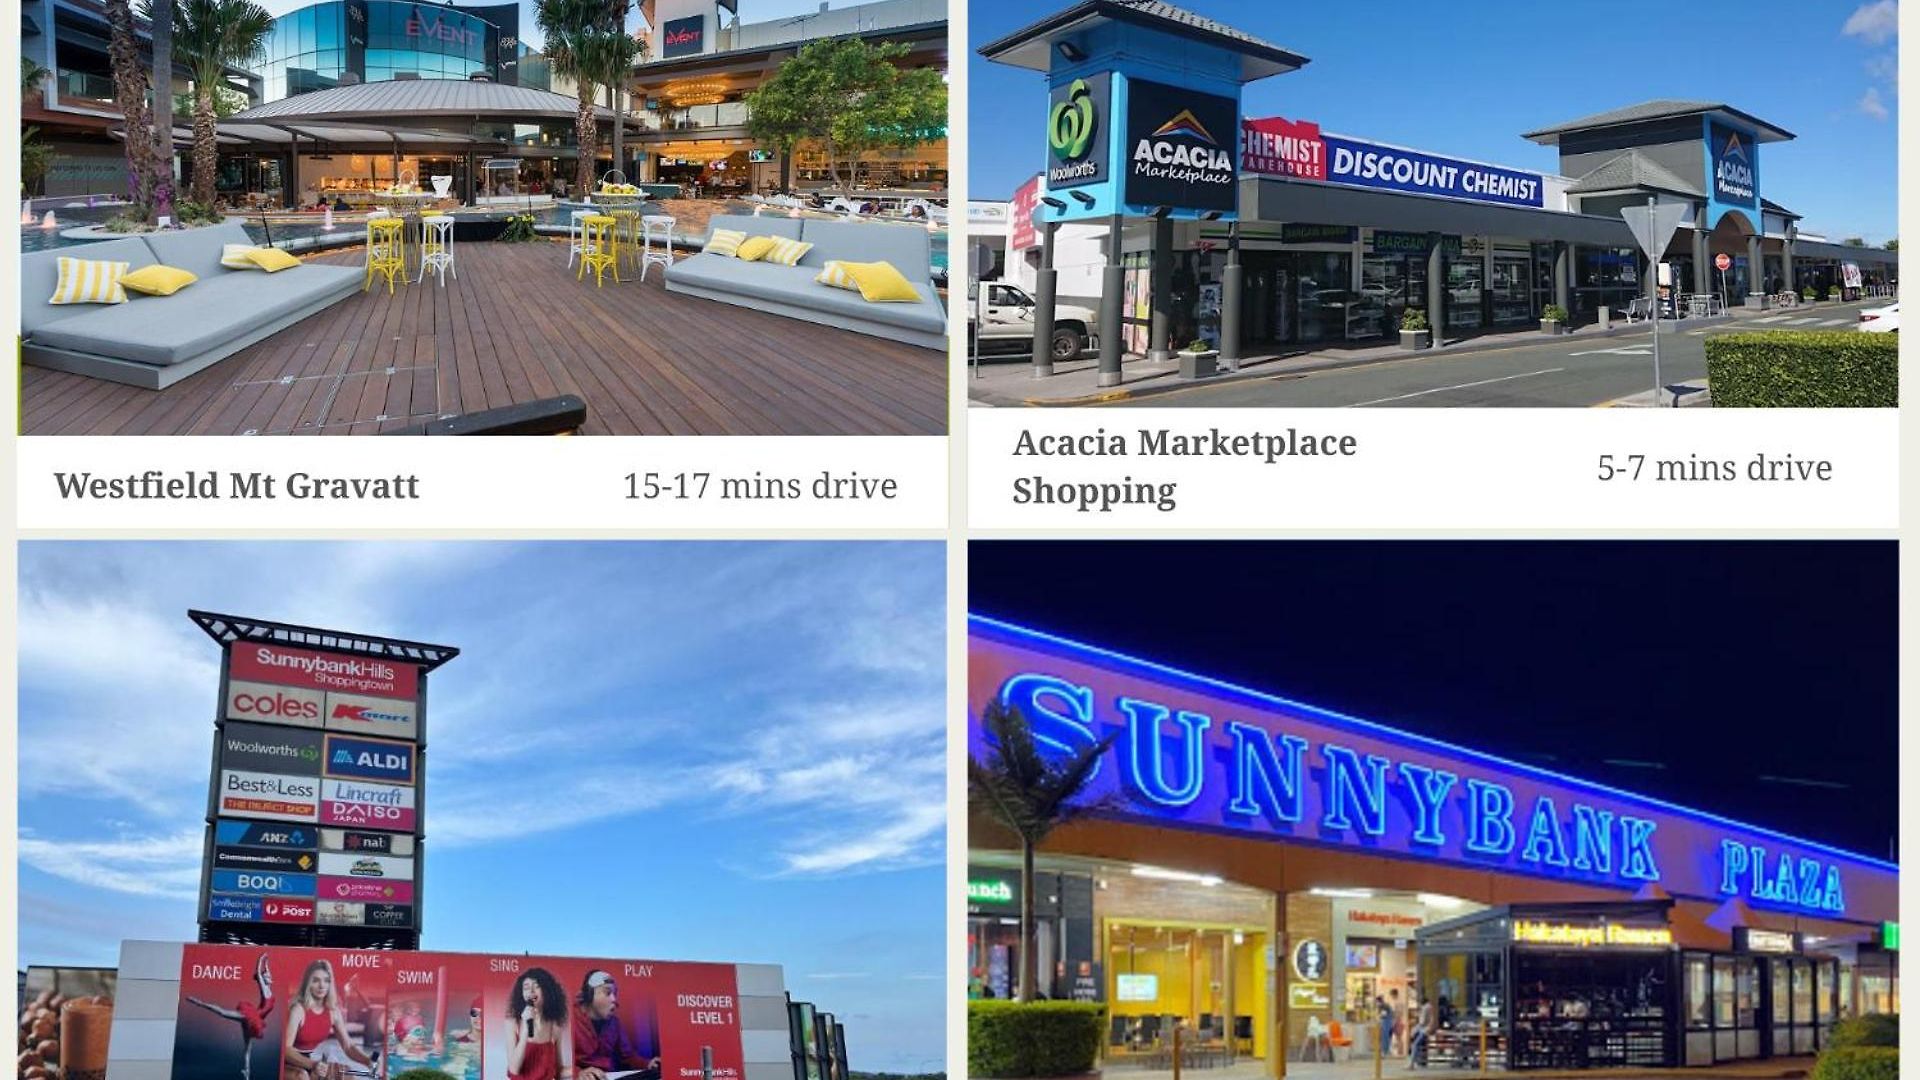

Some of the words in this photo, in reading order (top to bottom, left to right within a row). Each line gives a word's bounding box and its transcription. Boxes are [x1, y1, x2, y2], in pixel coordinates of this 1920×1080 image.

[406, 6, 479, 46] EVENT
[1134, 139, 1233, 172] ACACIA
[1049, 160, 1096, 182] Woolworths
[1136, 162, 1232, 185] Marketplace
[1243, 155, 1320, 177] AREHOUSE
[1333, 147, 1459, 190] DISCOUNT
[1462, 169, 1537, 200] CHEMIST
[1717, 159, 1753, 187] ACACIA
[314, 672, 394, 692] Shoppingtown
[233, 692, 318, 719] coles
[332, 703, 410, 723] Kmart
[228, 739, 298, 757] Woolworths
[356, 751, 407, 771] ALDI
[1001, 672, 1660, 882] SUNNYBANK
[336, 783, 402, 804] Lincraft
[333, 802, 401, 819] DAISO
[334, 815, 367, 824] JAPAN
[260, 832, 289, 844] ANZ
[238, 874, 278, 891] BOQ
[1721, 838, 1845, 913] PLAZA
[221, 909, 252, 919] Dental
[282, 907, 312, 917] POST
[342, 954, 381, 968] MOVE
[490, 958, 519, 973] SING
[624, 963, 654, 978] PLAY
[192, 964, 241, 981] DANCE
[397, 970, 434, 984] SWIM
[677, 994, 733, 1009] DISCOVER
[690, 1011, 725, 1025] LEVEL
[727, 1012, 733, 1025] 1
